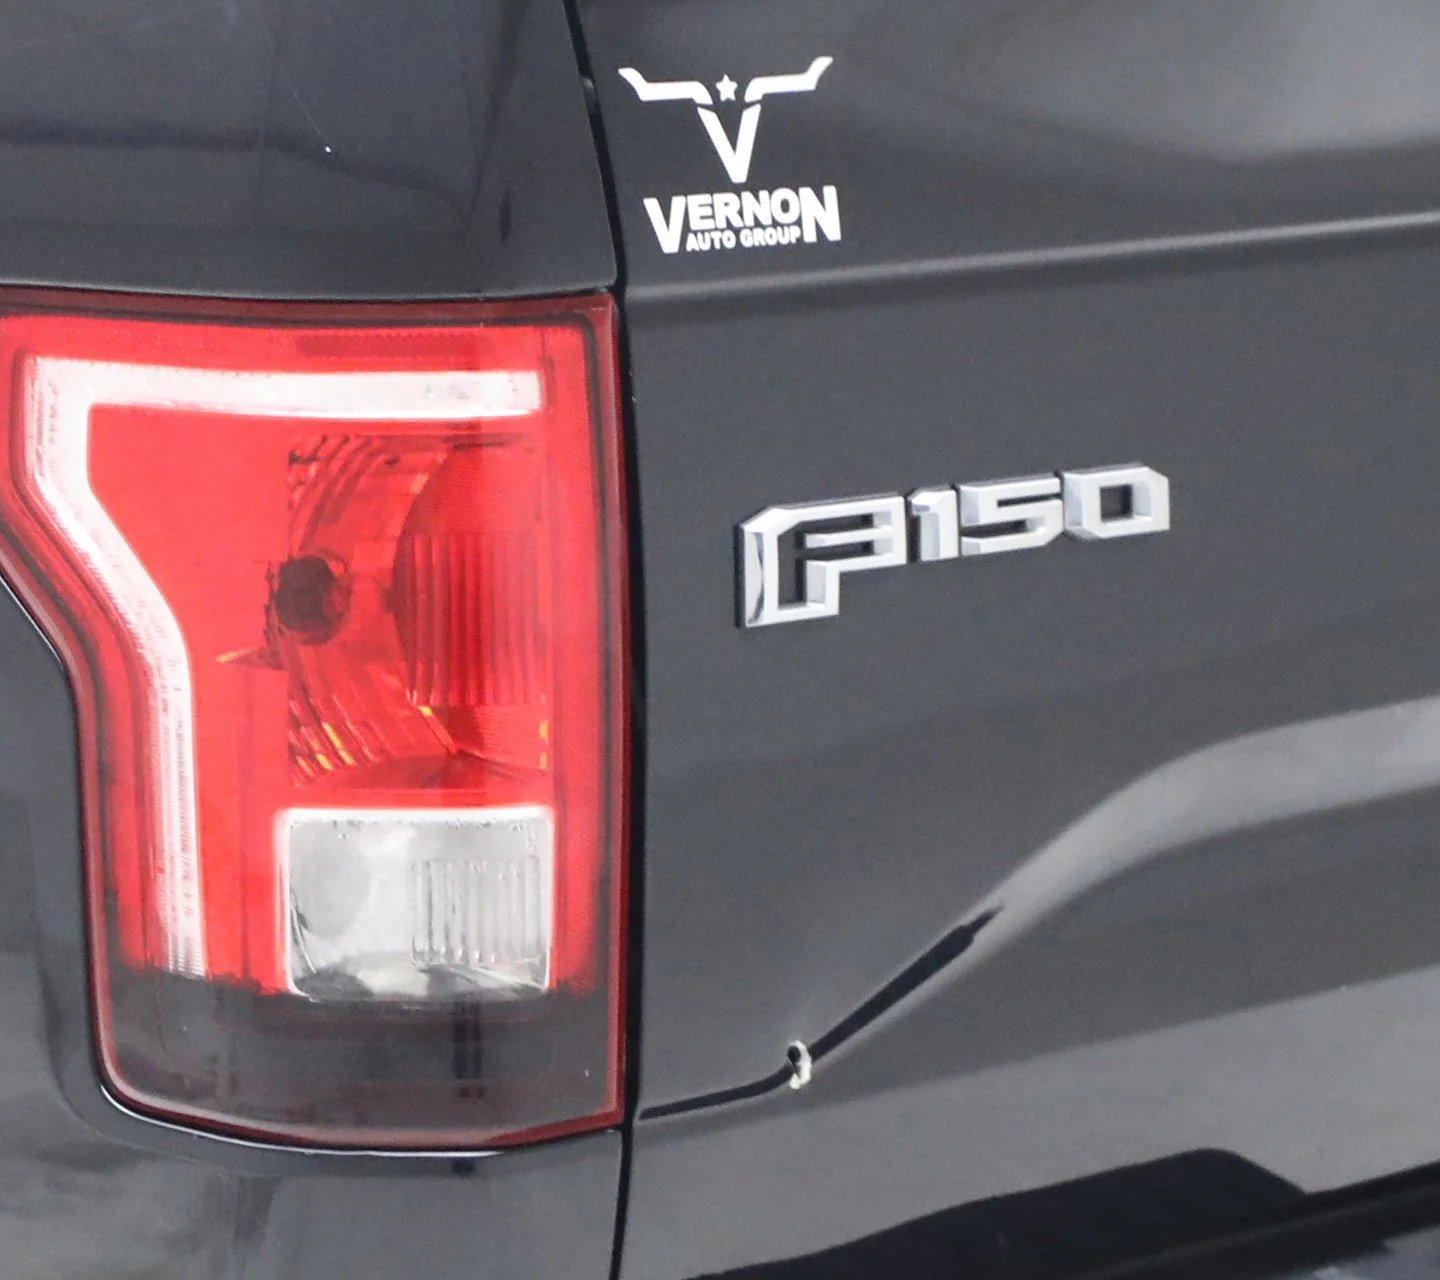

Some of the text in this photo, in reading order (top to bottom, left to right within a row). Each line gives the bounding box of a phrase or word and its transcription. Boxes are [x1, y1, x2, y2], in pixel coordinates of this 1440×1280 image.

[643, 184, 841, 254] VERNON
[686, 225, 802, 252] AUTO GROUP
